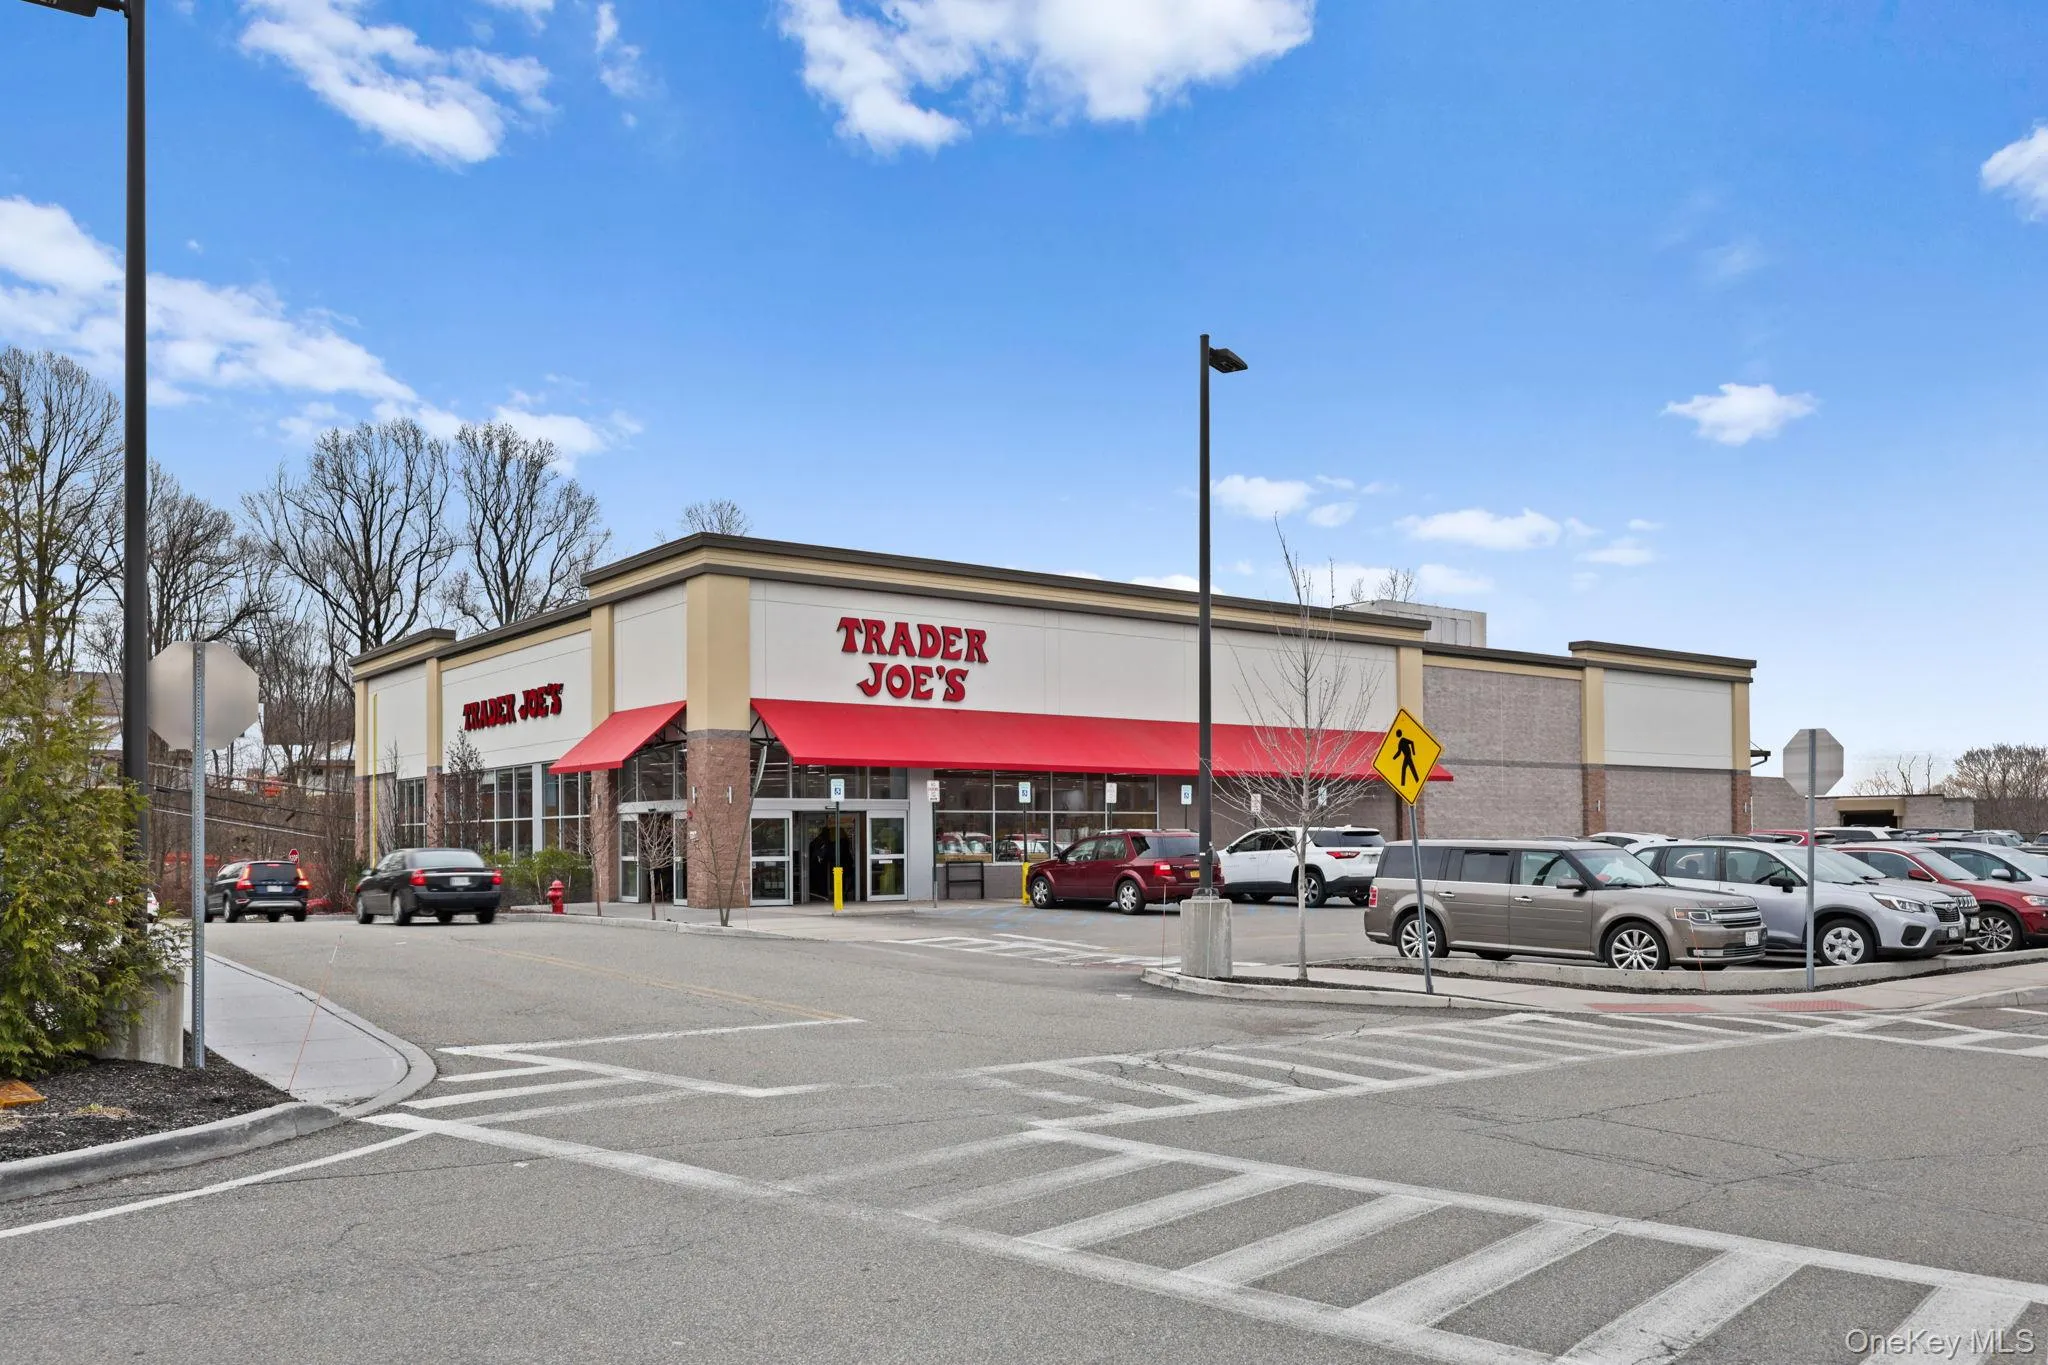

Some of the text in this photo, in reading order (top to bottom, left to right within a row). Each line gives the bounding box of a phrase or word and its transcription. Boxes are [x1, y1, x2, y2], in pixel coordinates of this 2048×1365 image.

[836, 617, 989, 663] TRADER
[856, 662, 969, 702] JOE'S
[463, 683, 564, 731] TRADER JOE'S
